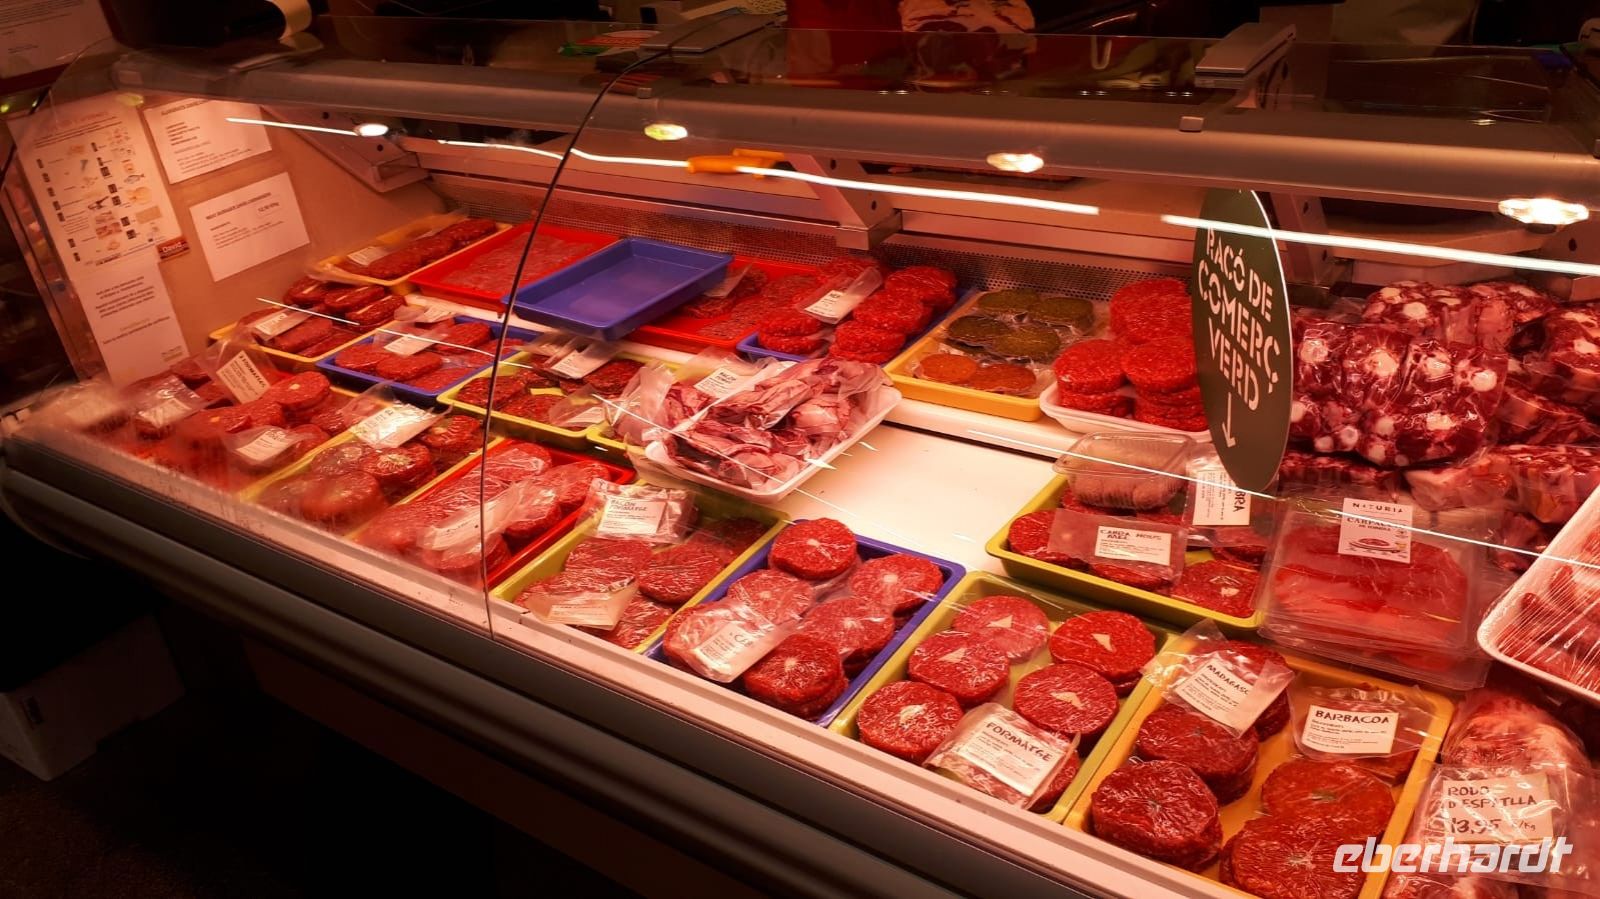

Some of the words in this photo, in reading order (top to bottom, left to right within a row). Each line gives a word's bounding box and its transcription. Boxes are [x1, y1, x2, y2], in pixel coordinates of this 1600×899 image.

[1206, 226, 1246, 292] RACÓ
[1249, 268, 1274, 323] DE
[1198, 258, 1281, 394] COMERÇ
[1208, 317, 1260, 411] VERD
[1206, 664, 1249, 695] MADAGASC
[1315, 710, 1389, 724] BARBACOA
[985, 722, 1053, 762] FORMATGE
[1450, 818, 1501, 834] 13,95
